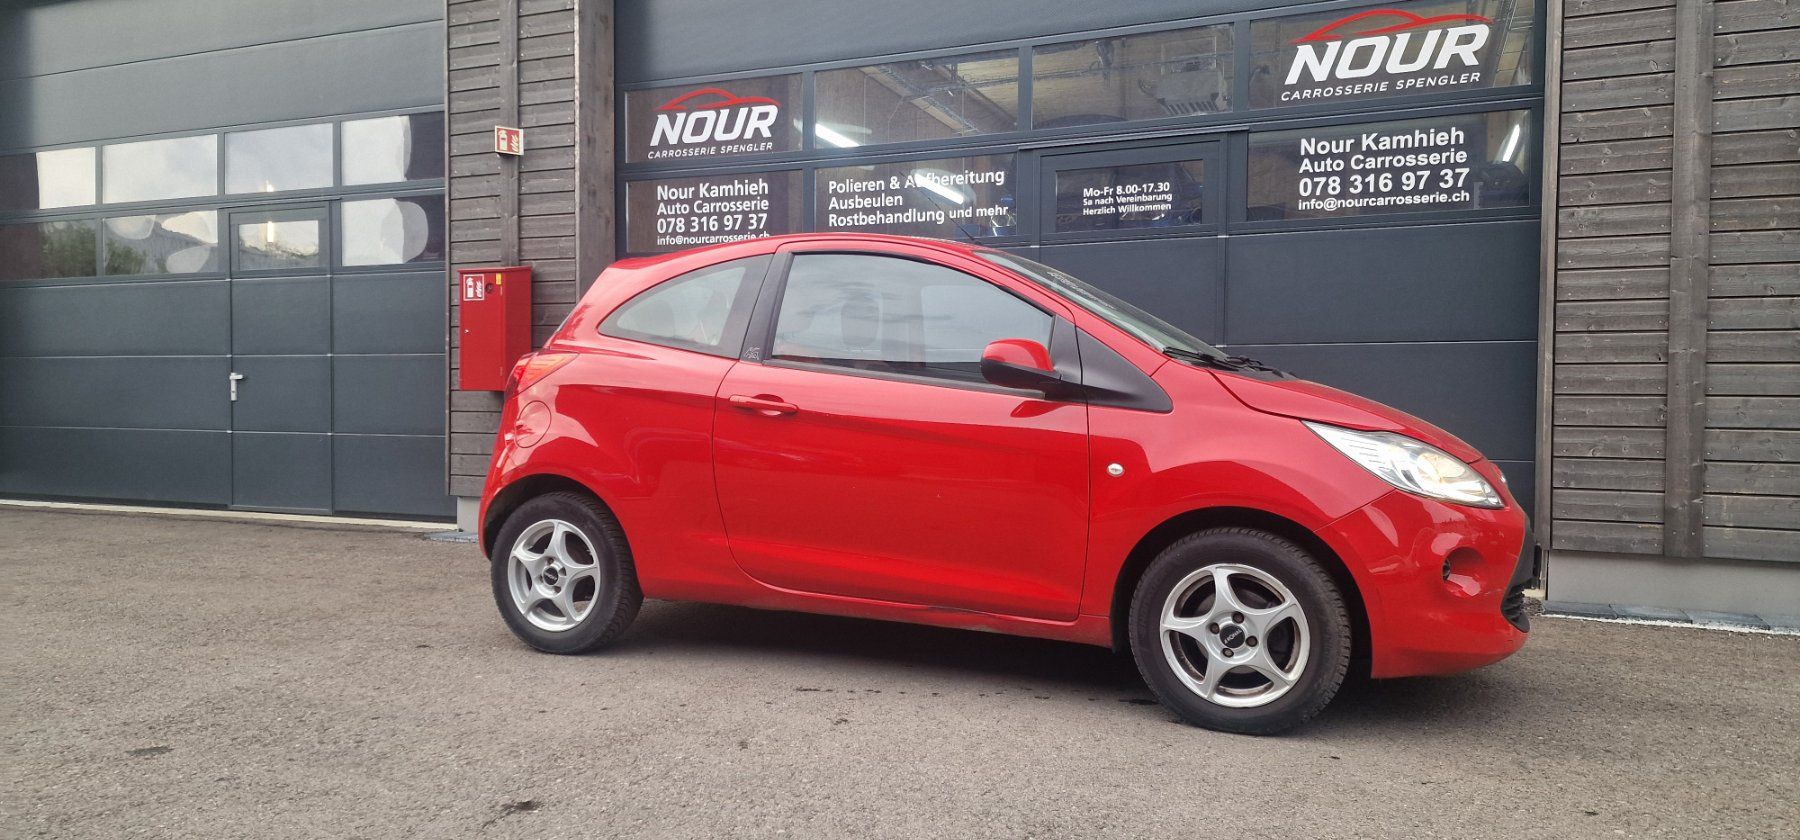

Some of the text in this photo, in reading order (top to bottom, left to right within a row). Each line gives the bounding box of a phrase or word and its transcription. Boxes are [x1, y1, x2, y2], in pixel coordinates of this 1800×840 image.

[1284, 24, 1490, 85] NOUR
[1281, 72, 1481, 101] CARROSSERIE SPENGLER
[650, 104, 778, 147] NOUR
[647, 142, 773, 160] CARROSSERIE SPENGLER
[1300, 127, 1465, 156] Nour Kamhieh
[1299, 148, 1468, 173] Auto Carrosserie
[657, 178, 769, 201] Nour Kamhieh
[828, 170, 1005, 194] Polieren & Afbereitung
[1083, 182, 1170, 198] Mo-Fr 8.00-17.30
[1299, 168, 1470, 197] 078 316 97 37
[656, 197, 769, 216] Auto Carrosserie
[828, 193, 903, 210] Ausbeulen
[1082, 203, 1172, 215] Herzlich Willkommen
[1083, 193, 1172, 206] Sa nach Vereinbarung
[1298, 190, 1470, 211] info@nourcarrosserie.ch
[657, 213, 768, 234] 078 316 97 37
[828, 205, 1009, 227] Rostbehandlung und mehr
